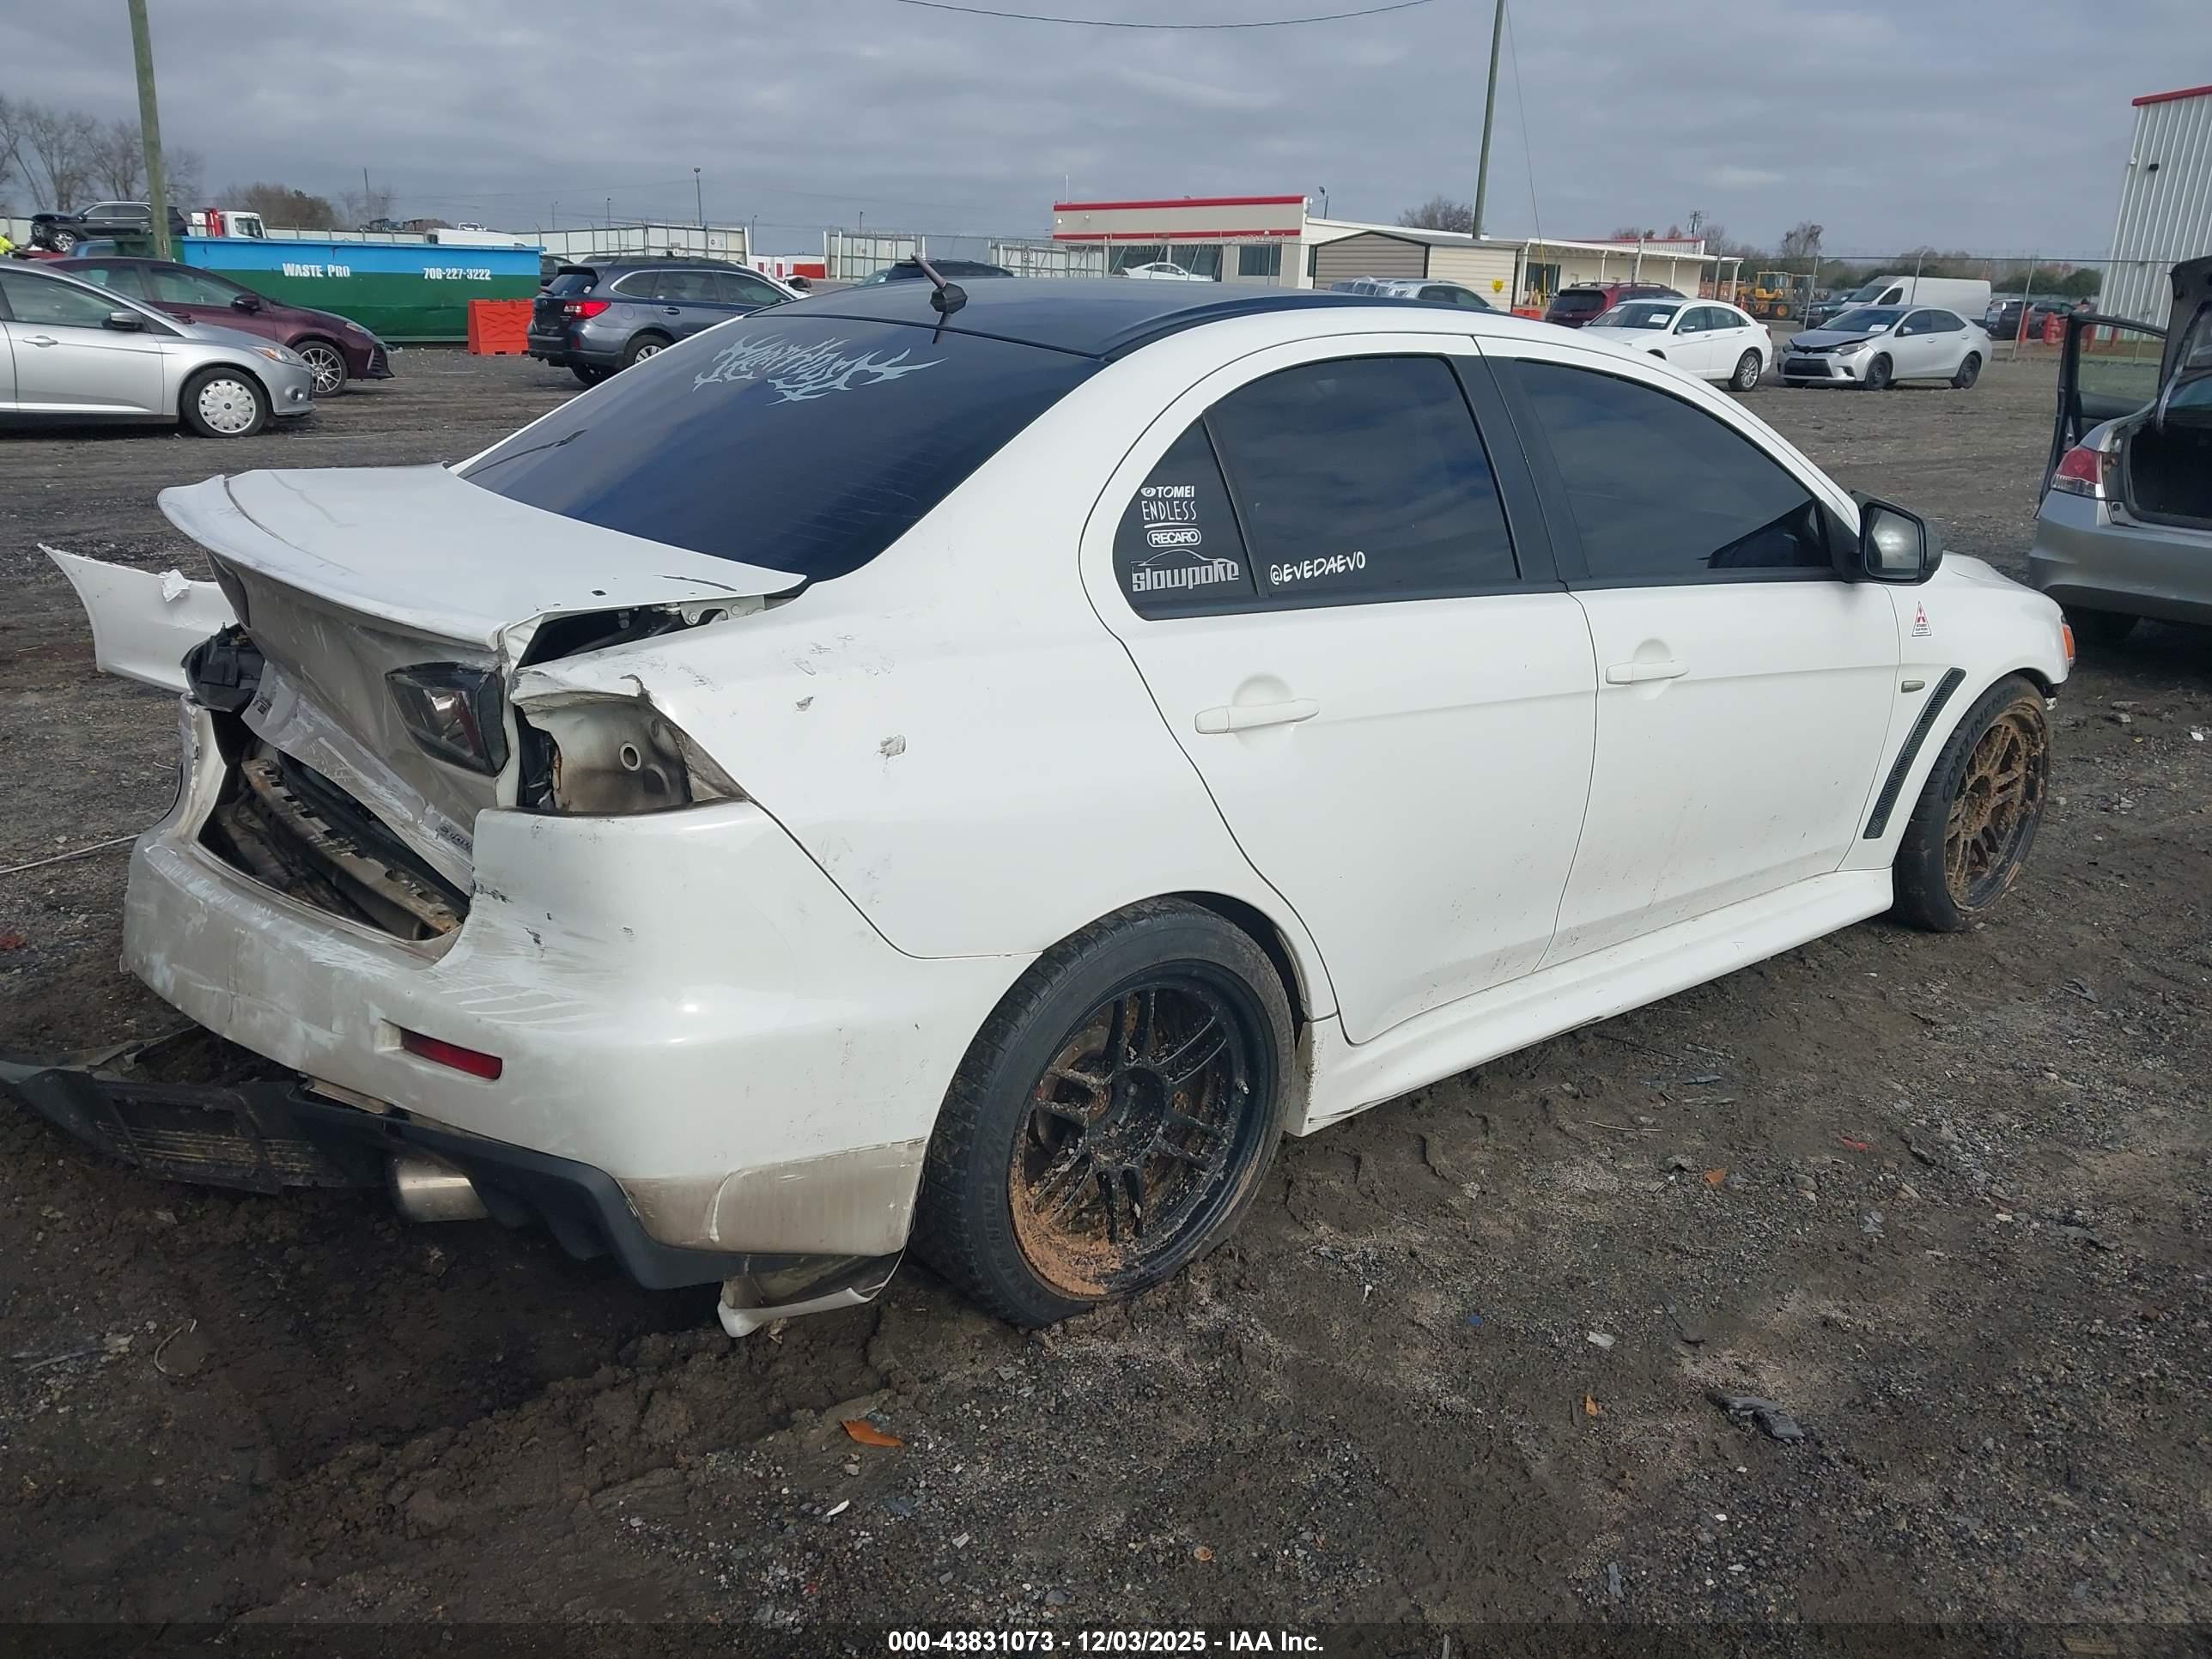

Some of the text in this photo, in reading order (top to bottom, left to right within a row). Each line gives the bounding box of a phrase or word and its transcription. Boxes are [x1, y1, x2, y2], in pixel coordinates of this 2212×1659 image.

[282, 262, 350, 277] WASTE PRO
[1156, 485, 1195, 498] TOMEI
[1141, 501, 1197, 520] ENDLESS
[1151, 531, 1199, 544] RECARO
[1132, 560, 1240, 592] slowpoke
[1270, 550, 1366, 585] @EVEDAEVO
